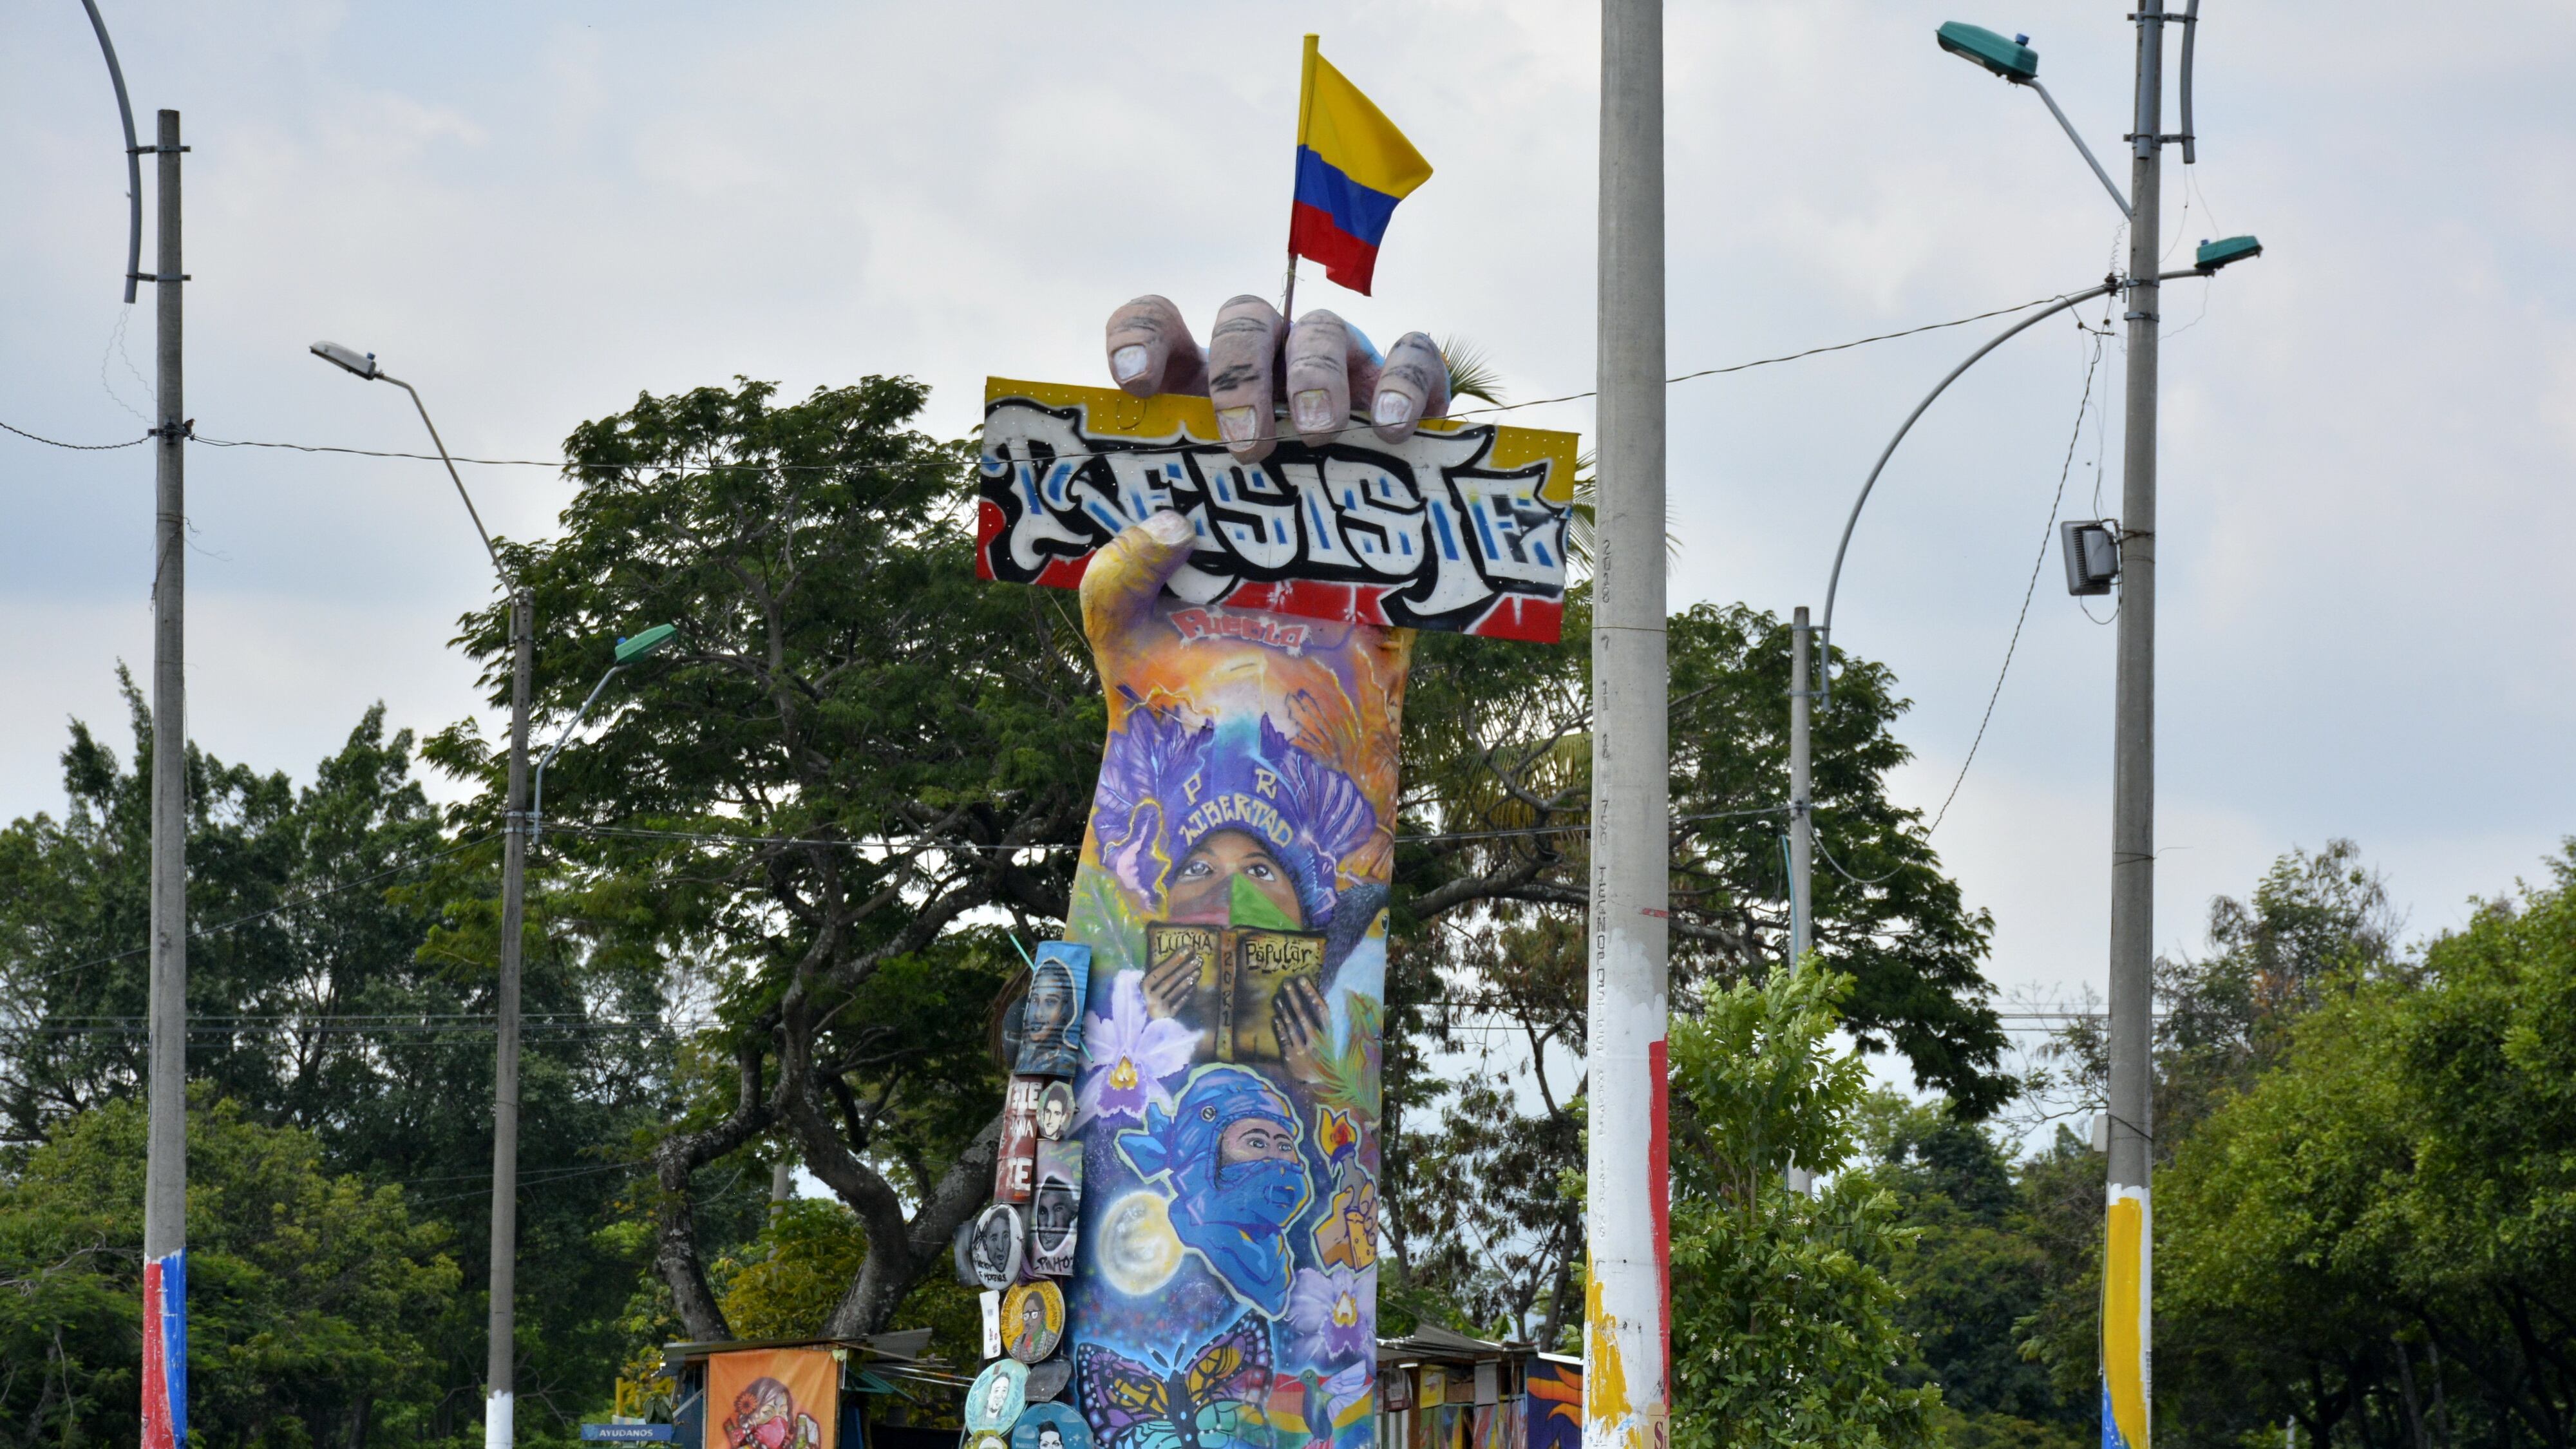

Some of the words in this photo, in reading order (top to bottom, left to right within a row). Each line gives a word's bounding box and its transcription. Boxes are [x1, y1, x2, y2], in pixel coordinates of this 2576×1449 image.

[980, 397, 1569, 622] RESISTE
[1179, 793, 1293, 848] LIBERTAD
[1157, 933, 1213, 954] LUCHA
